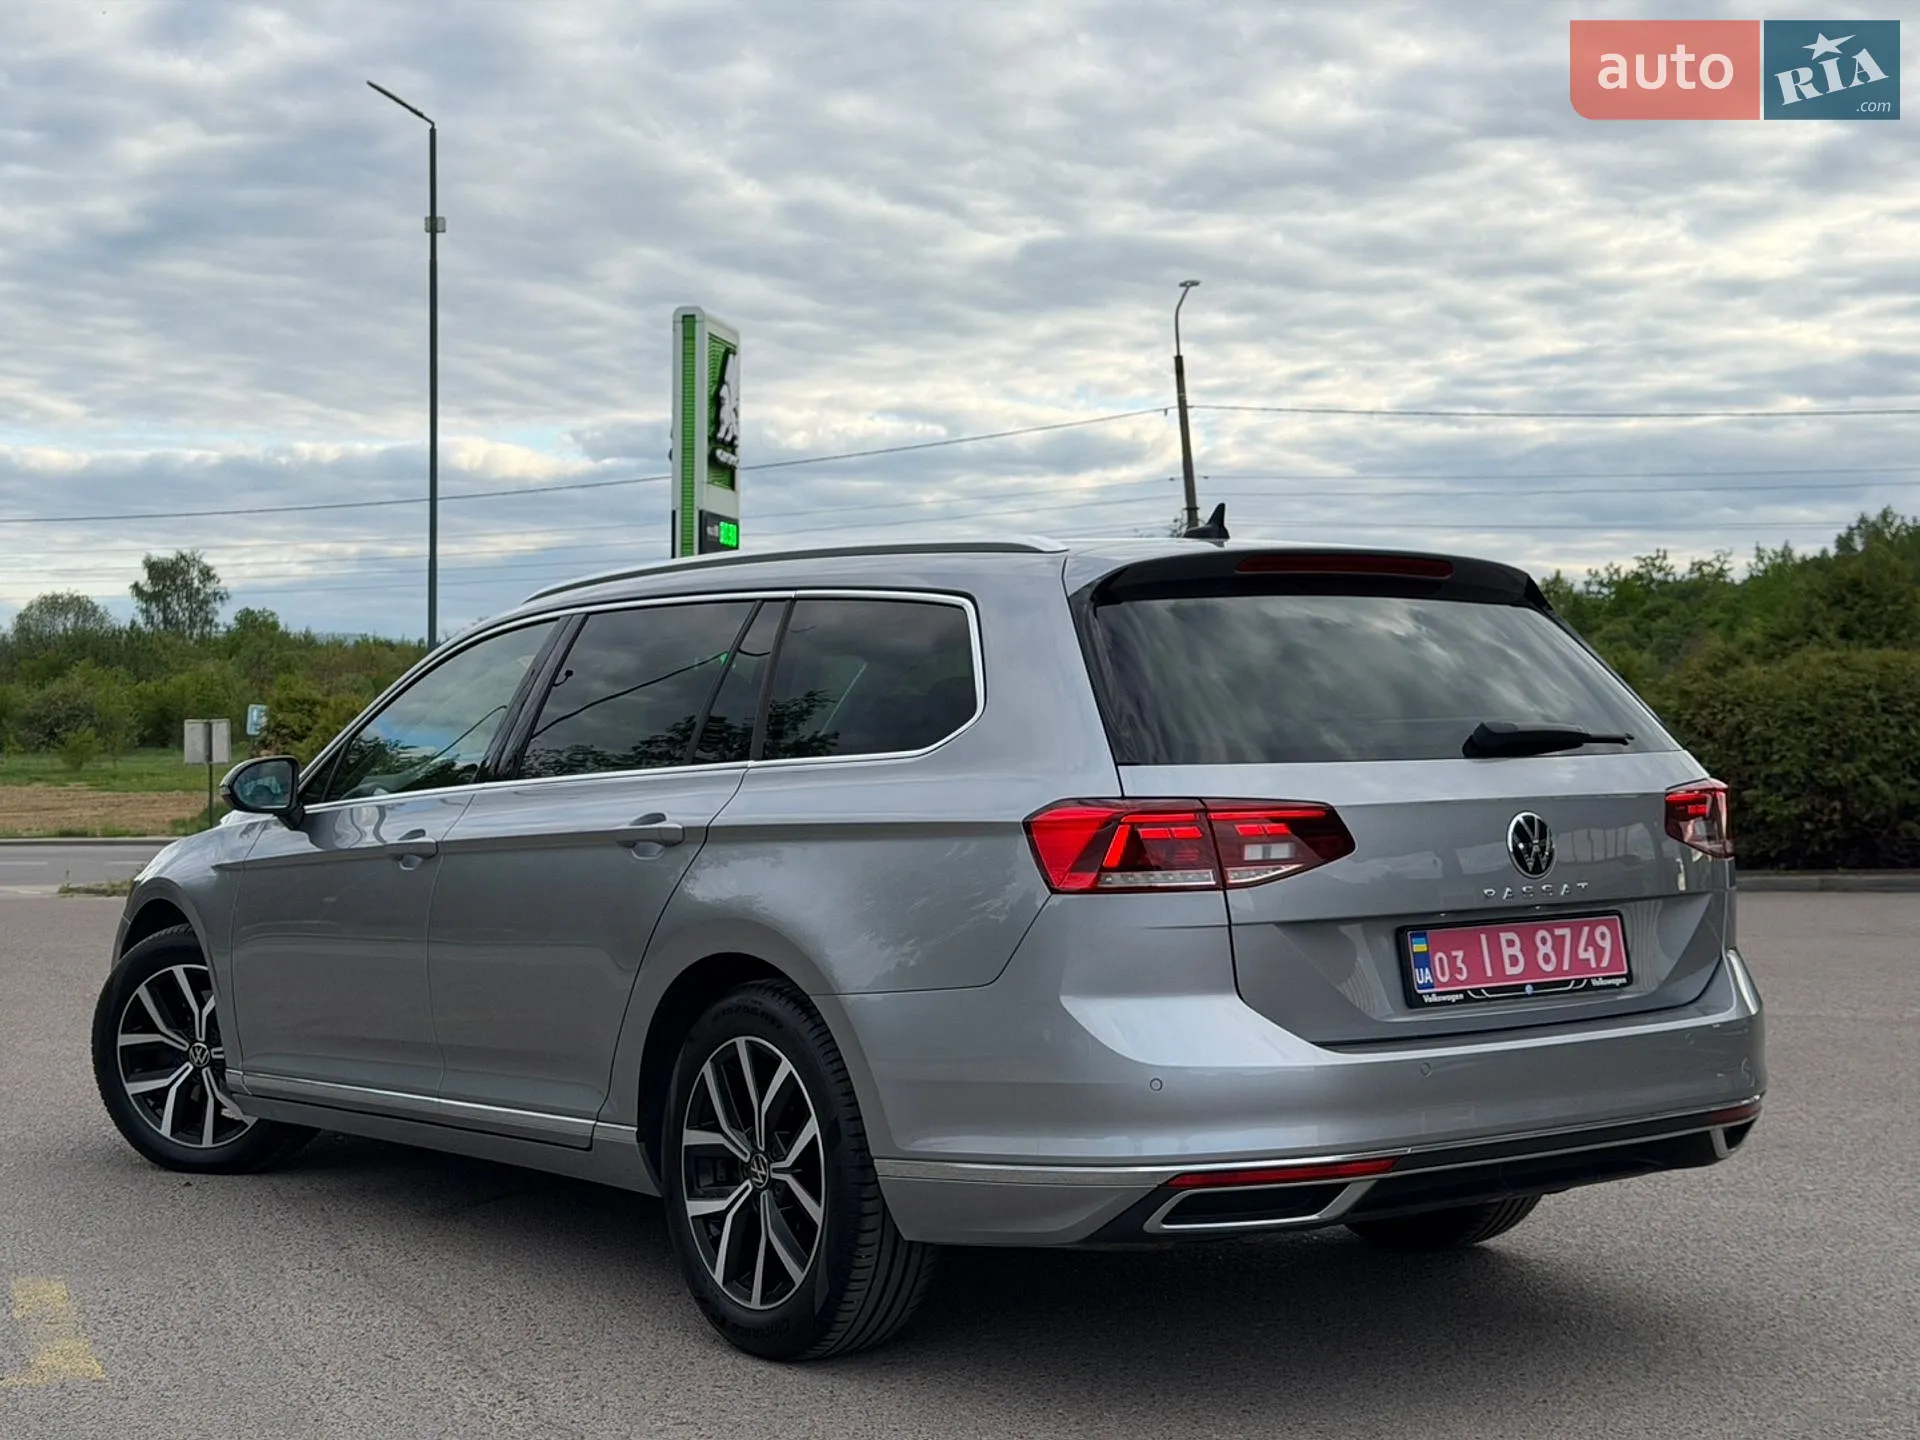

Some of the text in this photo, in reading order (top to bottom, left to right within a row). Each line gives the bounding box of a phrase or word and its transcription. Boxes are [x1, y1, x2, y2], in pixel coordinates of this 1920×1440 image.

[1483, 881, 1589, 900] PASSAT
[1433, 924, 1612, 983] 03 IB 8749
[1415, 967, 1433, 985] UA
